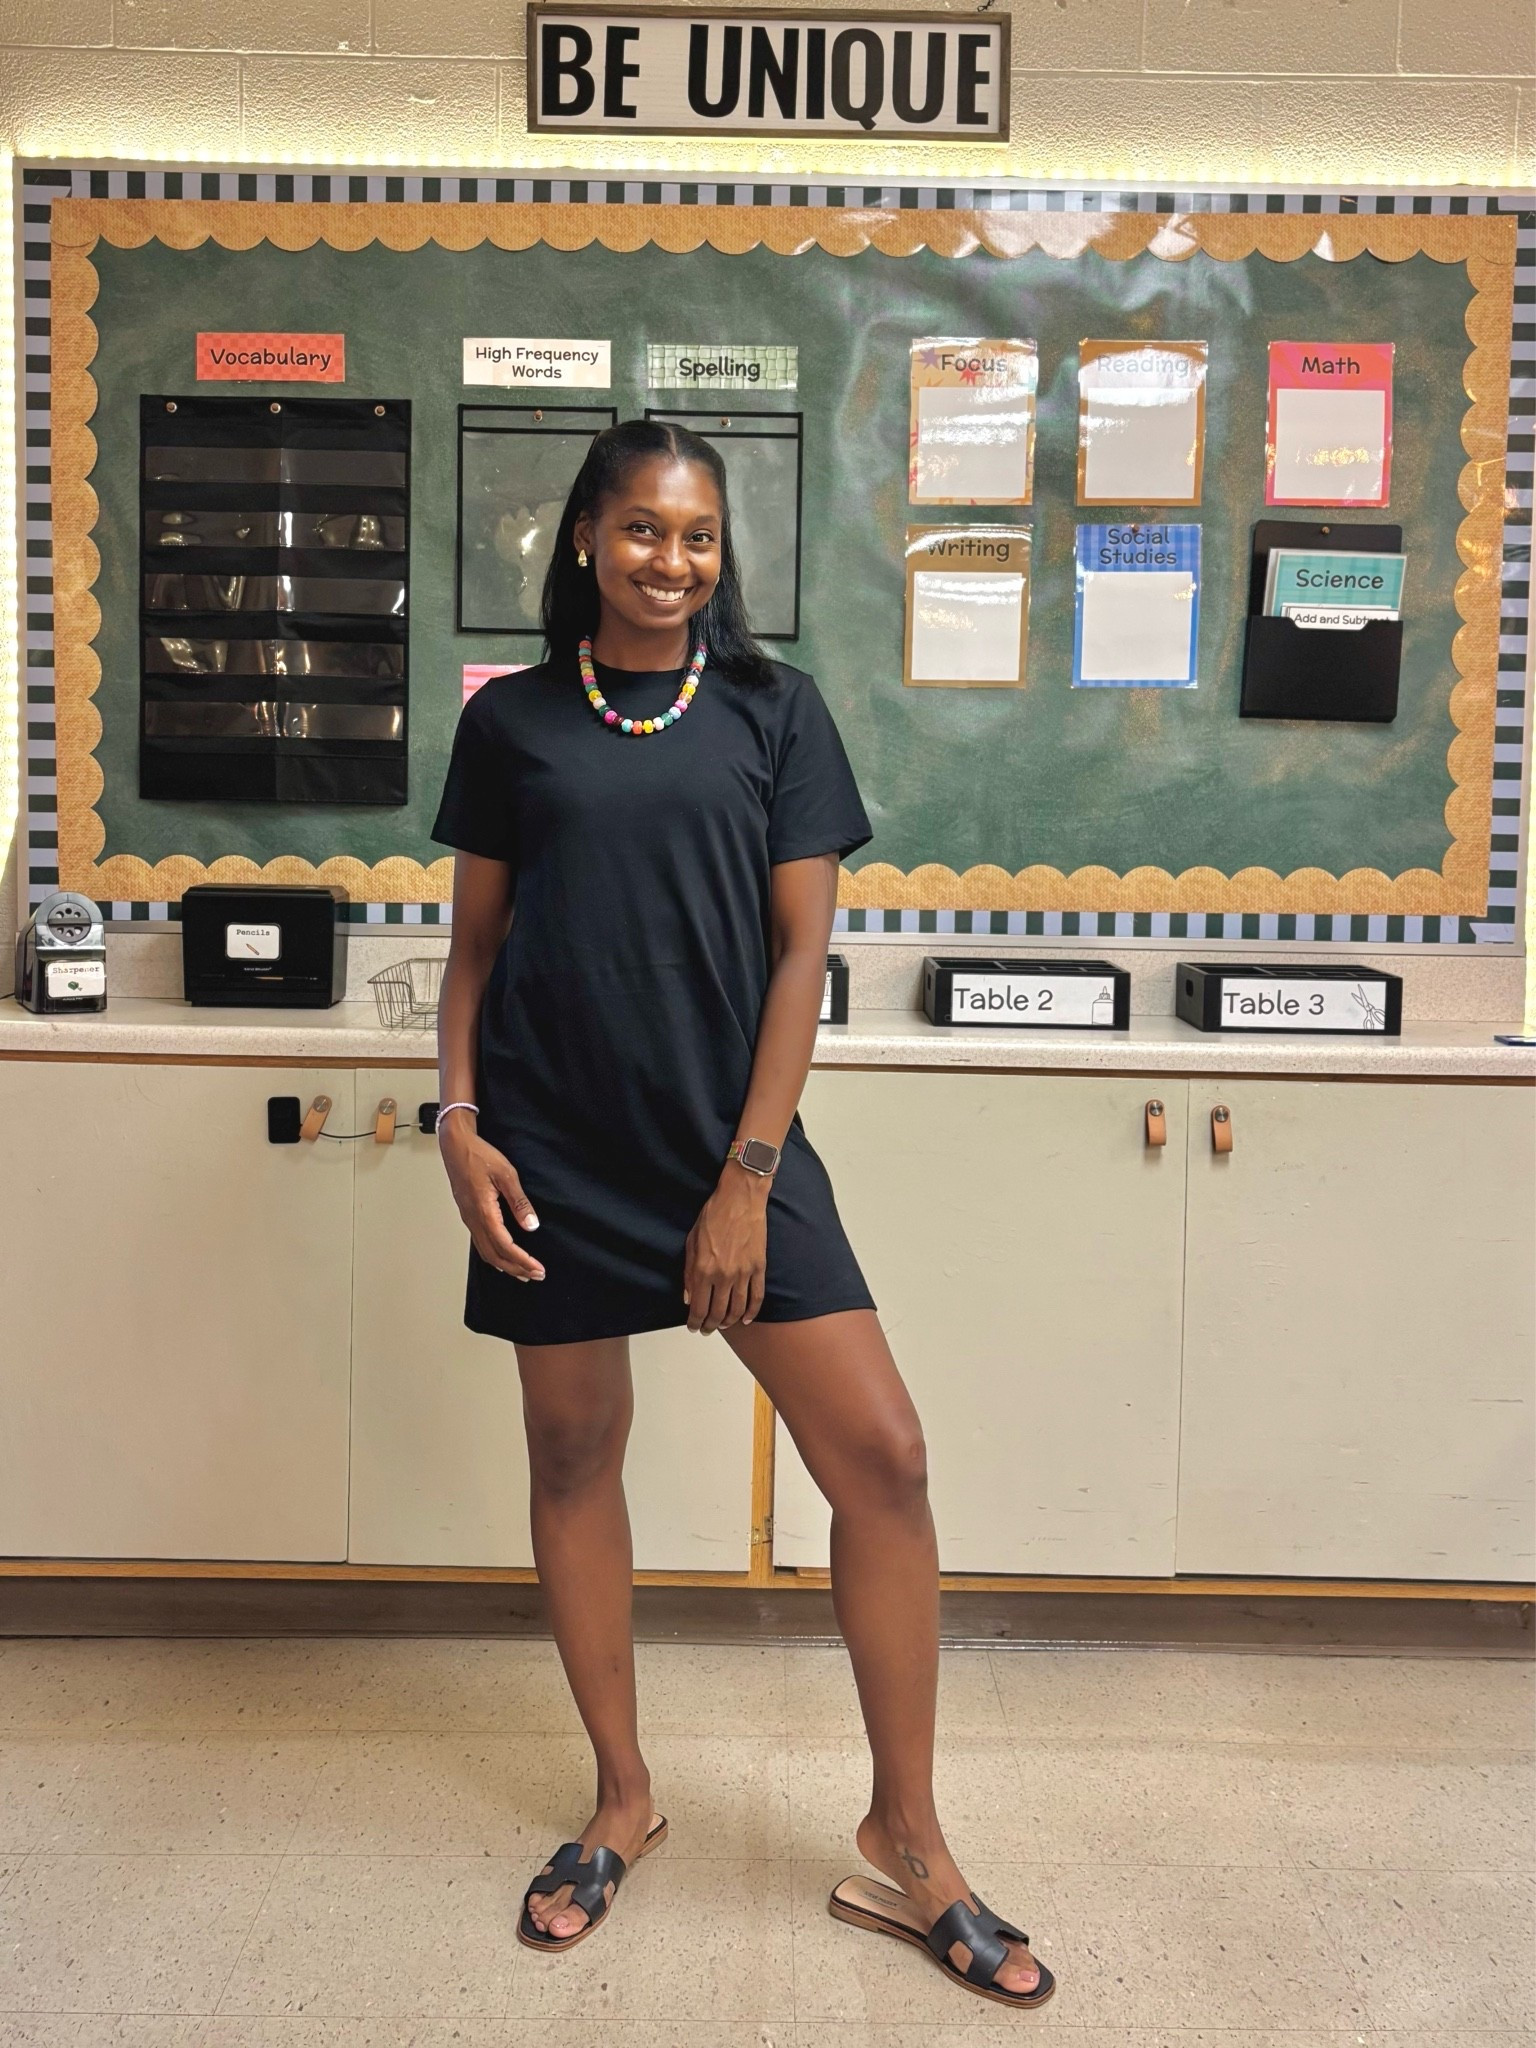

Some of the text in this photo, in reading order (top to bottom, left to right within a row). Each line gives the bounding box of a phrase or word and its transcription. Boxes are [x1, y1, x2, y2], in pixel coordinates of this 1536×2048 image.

[541, 23, 991, 130] BE UNIQUE
[210, 346, 331, 371] Vocabulary
[475, 346, 599, 365] High Frequency
[940, 354, 1008, 372] Focus
[1301, 356, 1360, 374] Math
[512, 365, 562, 379] Words
[679, 356, 761, 381] Spelling
[1097, 356, 1189, 377] Reading
[1108, 528, 1170, 545] Social
[929, 539, 1010, 562] Writing
[1100, 547, 1177, 564] Studies
[1295, 568, 1384, 589] Science
[1295, 613, 1317, 624] Add
[1320, 615, 1340, 624] and
[52, 966, 100, 975] Sharpener
[953, 985, 1054, 1011] Table 2
[1223, 989, 1324, 1015] Table 3
